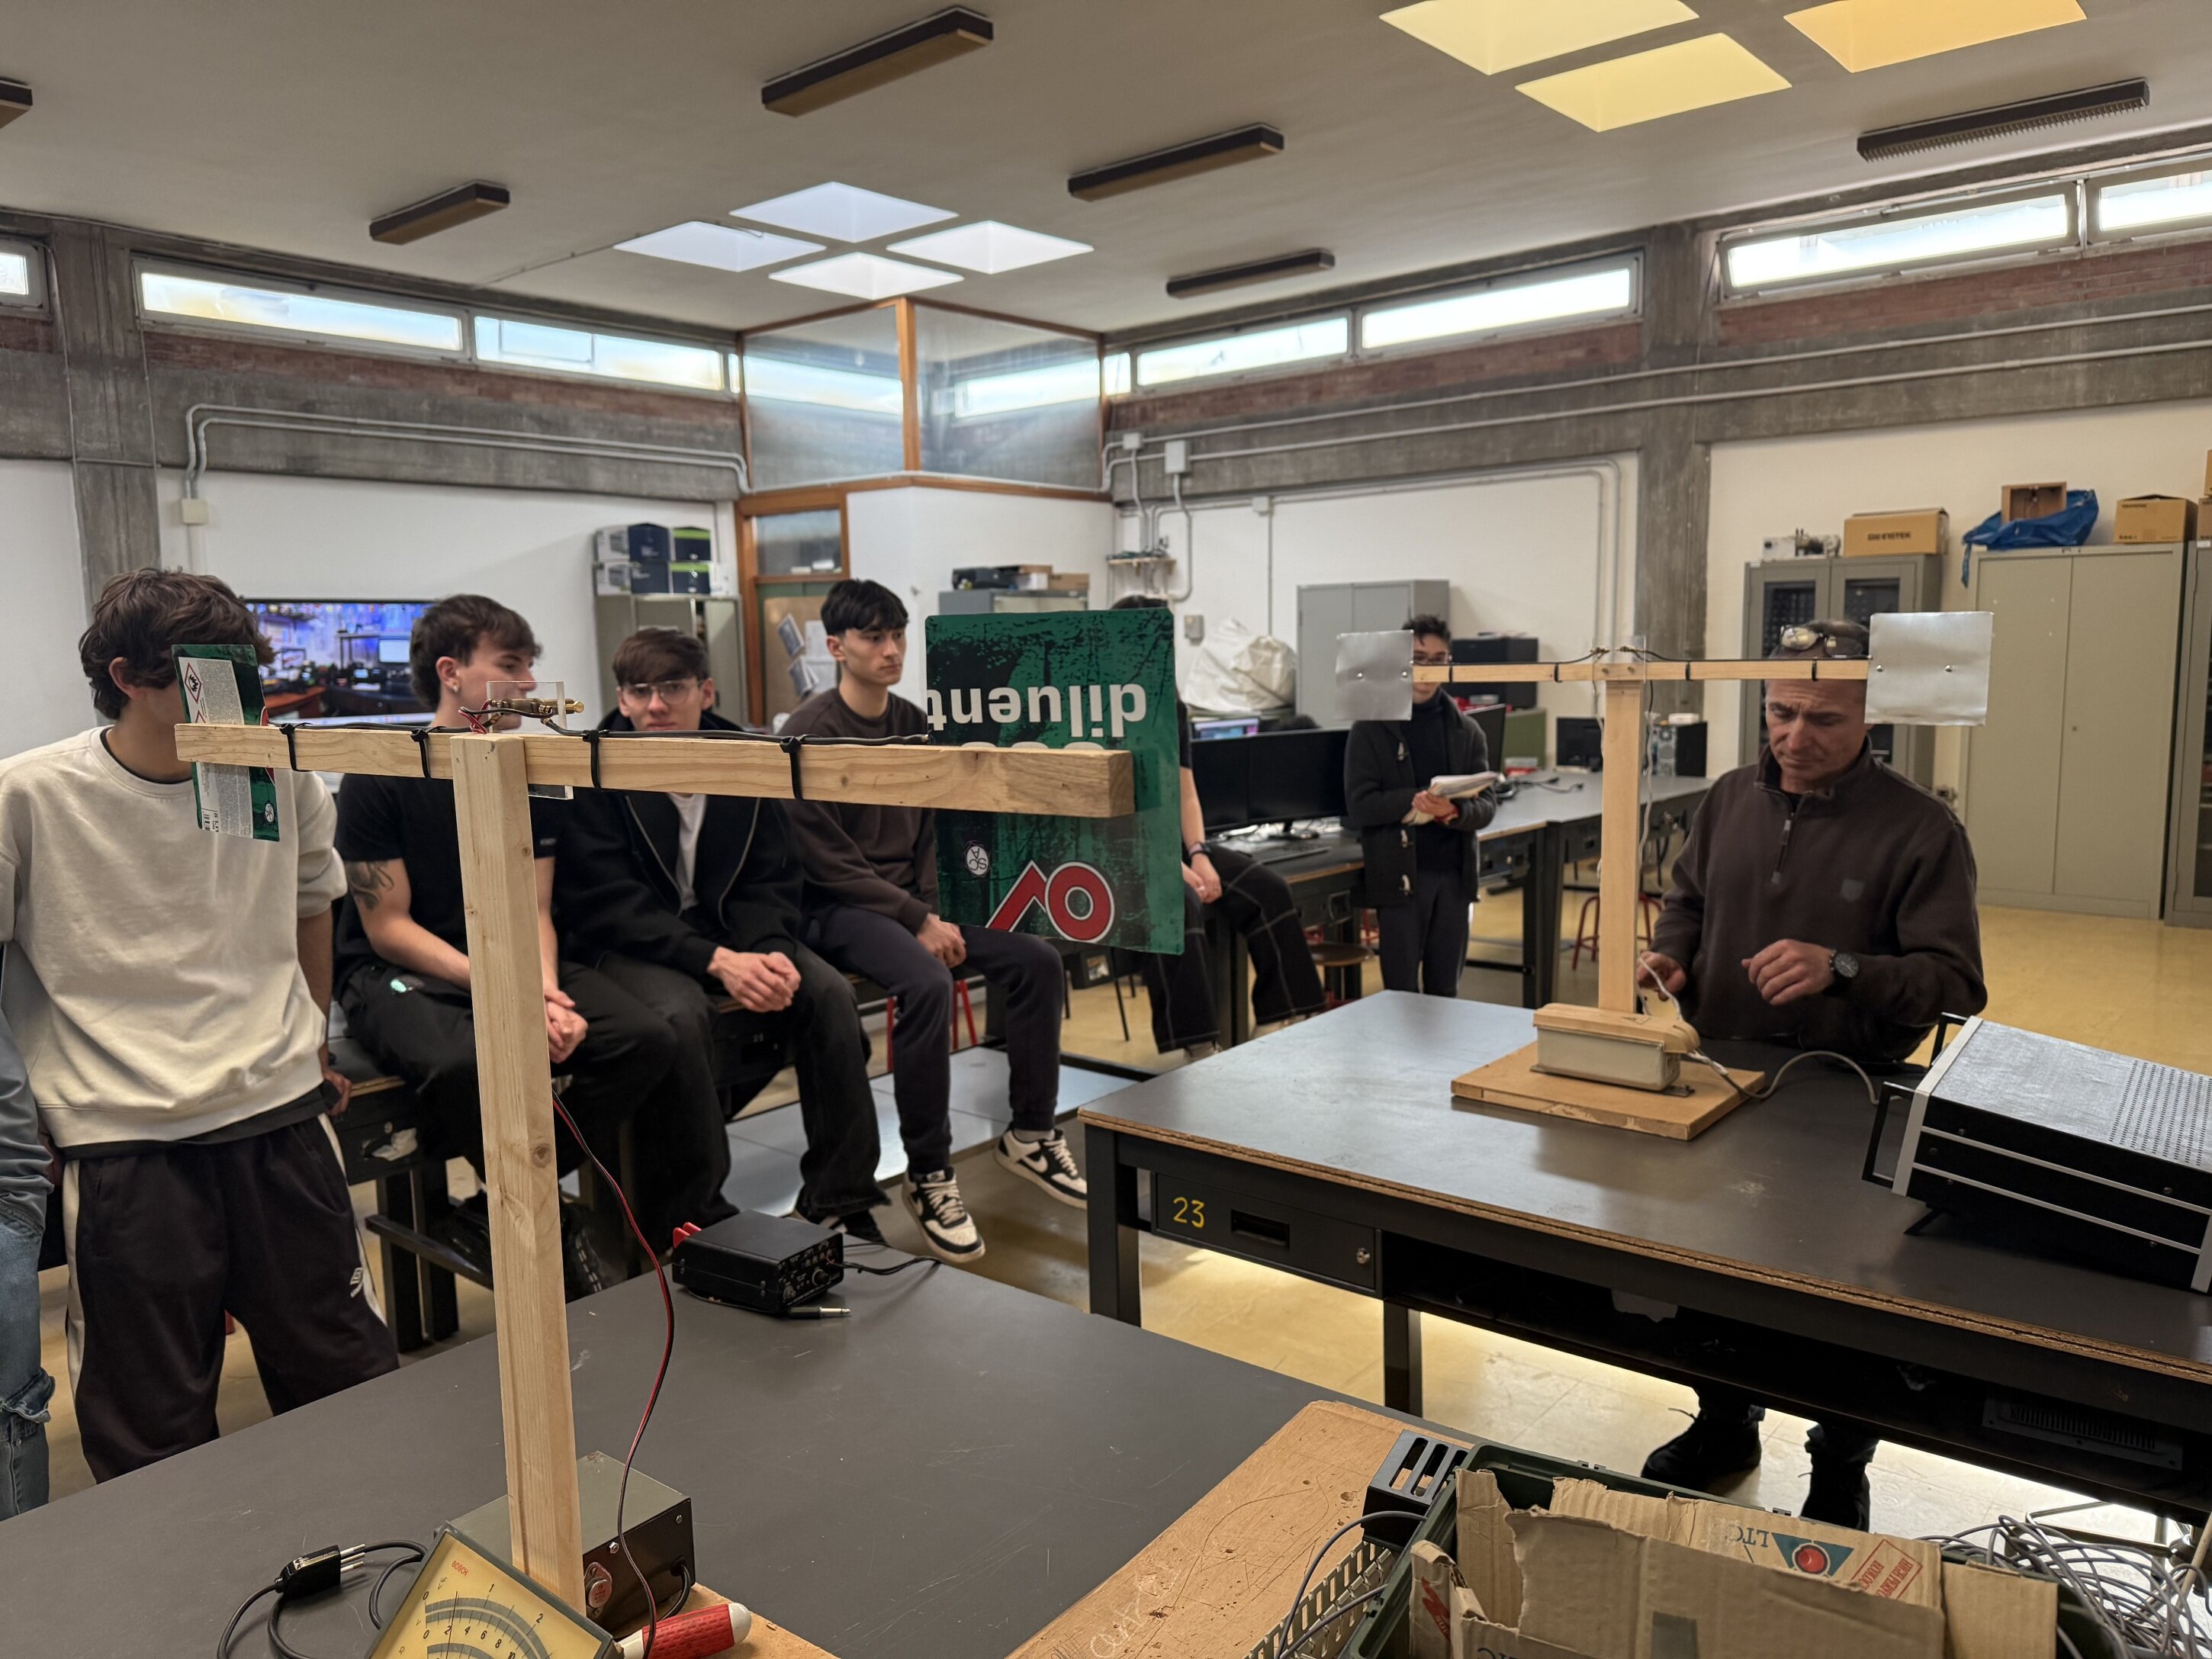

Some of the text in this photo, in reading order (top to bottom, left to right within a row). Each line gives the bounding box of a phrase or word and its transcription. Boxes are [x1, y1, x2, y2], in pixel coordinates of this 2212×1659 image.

[927, 683, 1146, 738] diluent
[1173, 1197, 1204, 1228] 23
[452, 1561, 469, 1576] BOSCH
[489, 1583, 494, 1593] 1
[536, 1613, 543, 1623] 2
[445, 1625, 452, 1635] 2
[465, 1626, 471, 1635] 4
[481, 1630, 487, 1639] 6
[495, 1639, 502, 1648] 8
